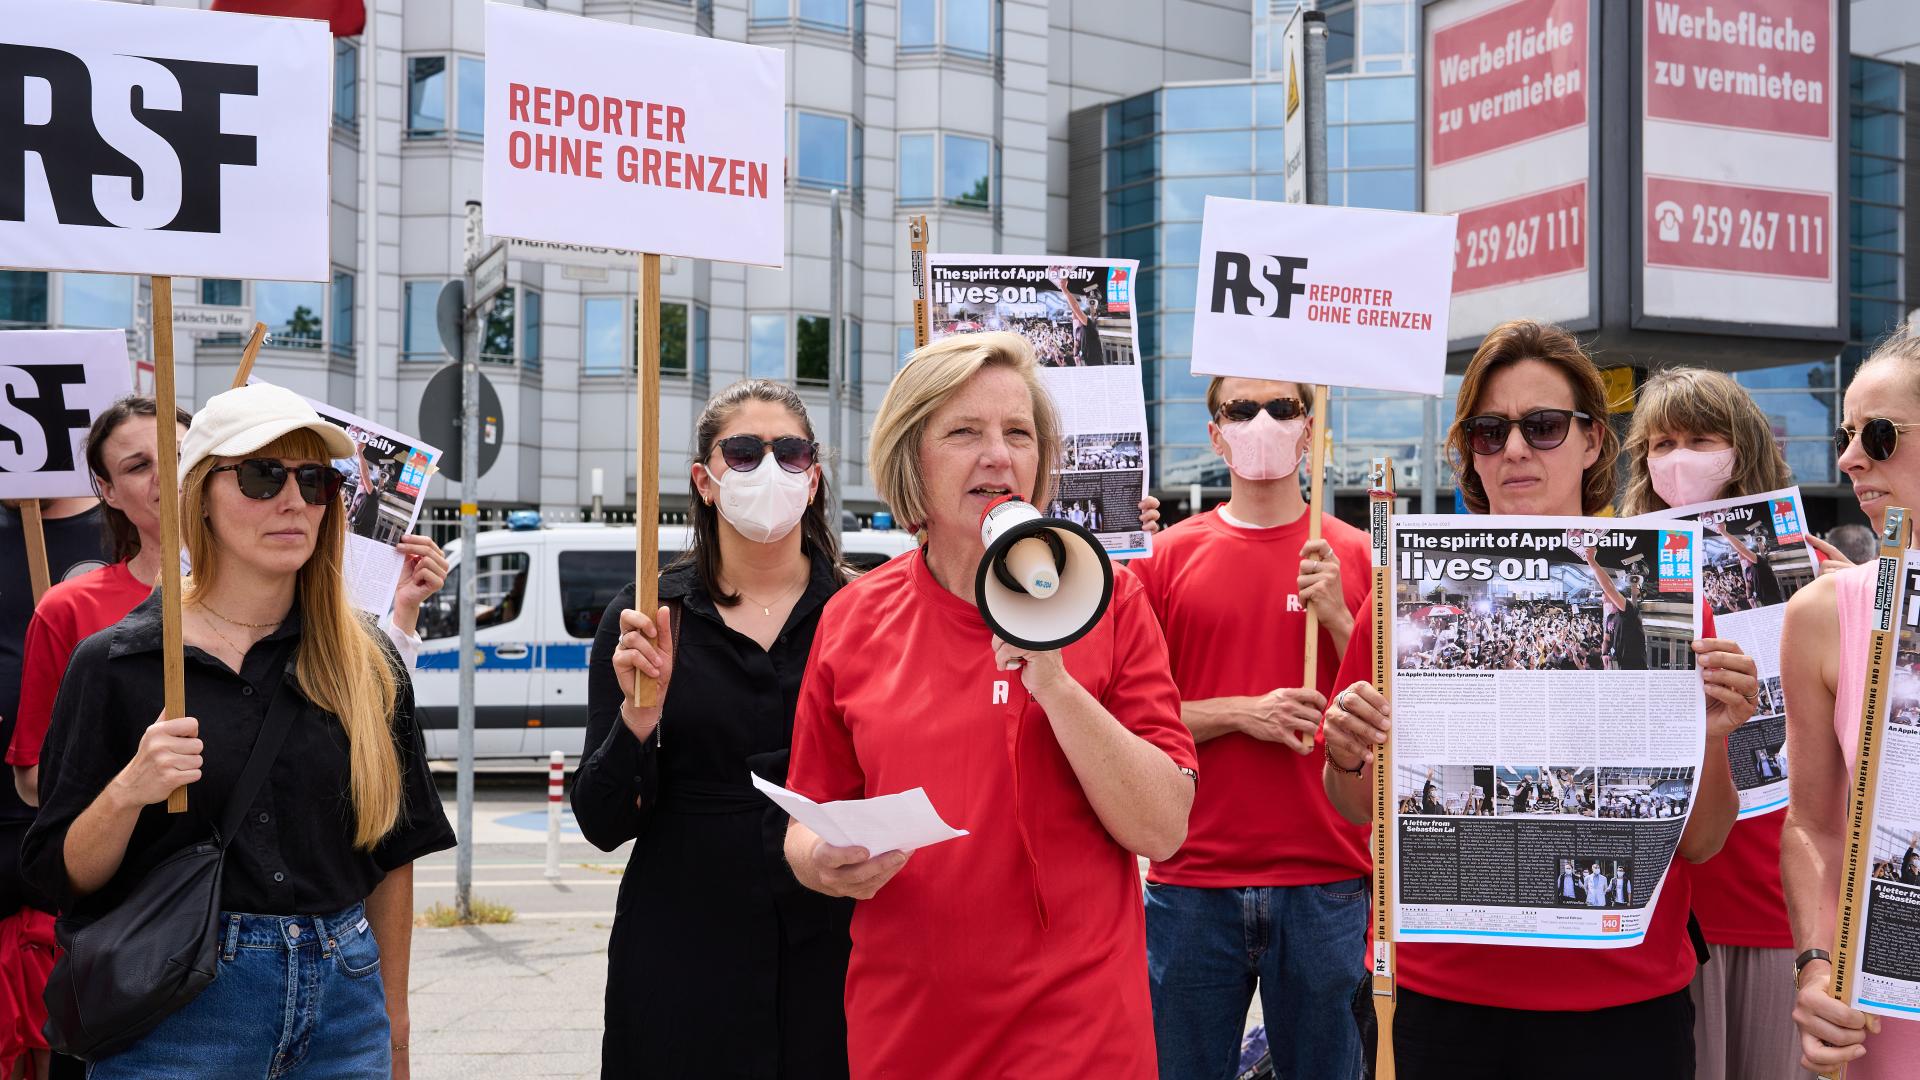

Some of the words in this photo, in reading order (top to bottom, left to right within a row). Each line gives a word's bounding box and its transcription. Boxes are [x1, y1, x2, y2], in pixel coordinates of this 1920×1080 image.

[1656, 1, 1816, 54] Werbefläche
[1439, 18, 1574, 88] Werbefläche
[1655, 61, 1685, 87] zu
[1693, 64, 1823, 104] vermieten
[509, 82, 686, 144] REPORTER
[1439, 108, 1463, 134] zu
[1469, 69, 1581, 125] vermieten
[0, 42, 258, 234] RSF
[508, 130, 603, 180] OHNE
[616, 145, 768, 200] GRENZEN
[1466, 225, 1501, 269] 259
[1505, 215, 1541, 261] 267
[1547, 207, 1579, 252] 111
[1692, 204, 1733, 246] 259
[1739, 209, 1780, 250] 267
[1787, 214, 1823, 255] 111
[934, 268, 961, 280] The
[962, 268, 1000, 282] spirit
[1001, 268, 1017, 280] of
[1017, 268, 1058, 282] Apple
[1059, 268, 1095, 282] Daily
[1211, 250, 1309, 319] RSF
[935, 283, 998, 304] lives
[1002, 286, 1037, 304] on
[1309, 284, 1393, 307] REPORTER
[173, 312, 217, 324] ärkisches
[1307, 304, 1351, 324] OHNE
[1357, 308, 1432, 331] GRENZEN
[0, 364, 91, 472] SF
[359, 432, 396, 455] Daily
[1714, 506, 1754, 524] Daily
[1400, 532, 1438, 549] The
[1440, 532, 1495, 551] spirit
[1497, 532, 1518, 548] of
[1520, 532, 1581, 551] Apple
[1583, 533, 1637, 550] Daily
[1400, 551, 1493, 581] lives
[1498, 556, 1550, 581] on
[1878, 559, 1887, 587] Freiheit
[1875, 588, 1883, 608] Keine
[1884, 559, 1896, 609] Pressefreiheit
[1874, 633, 1884, 665] FOLTER.
[1871, 666, 1879, 684] UND
[1863, 688, 1877, 756] UNTERDRÜCKUNG
[1898, 727, 1918, 736] Apple
[1378, 753, 1384, 761] IN
[1857, 760, 1868, 797] LÄNDERN
[1854, 800, 1863, 828] VIELEN
[1853, 831, 1860, 840] IN
[1846, 843, 1858, 902] JOURNALISTEN
[1882, 886, 1909, 897] letter
[1602, 919, 1617, 928] 140
[1840, 906, 1851, 949] RISKIEREN
[1835, 951, 1847, 992] WAHRHEIT
